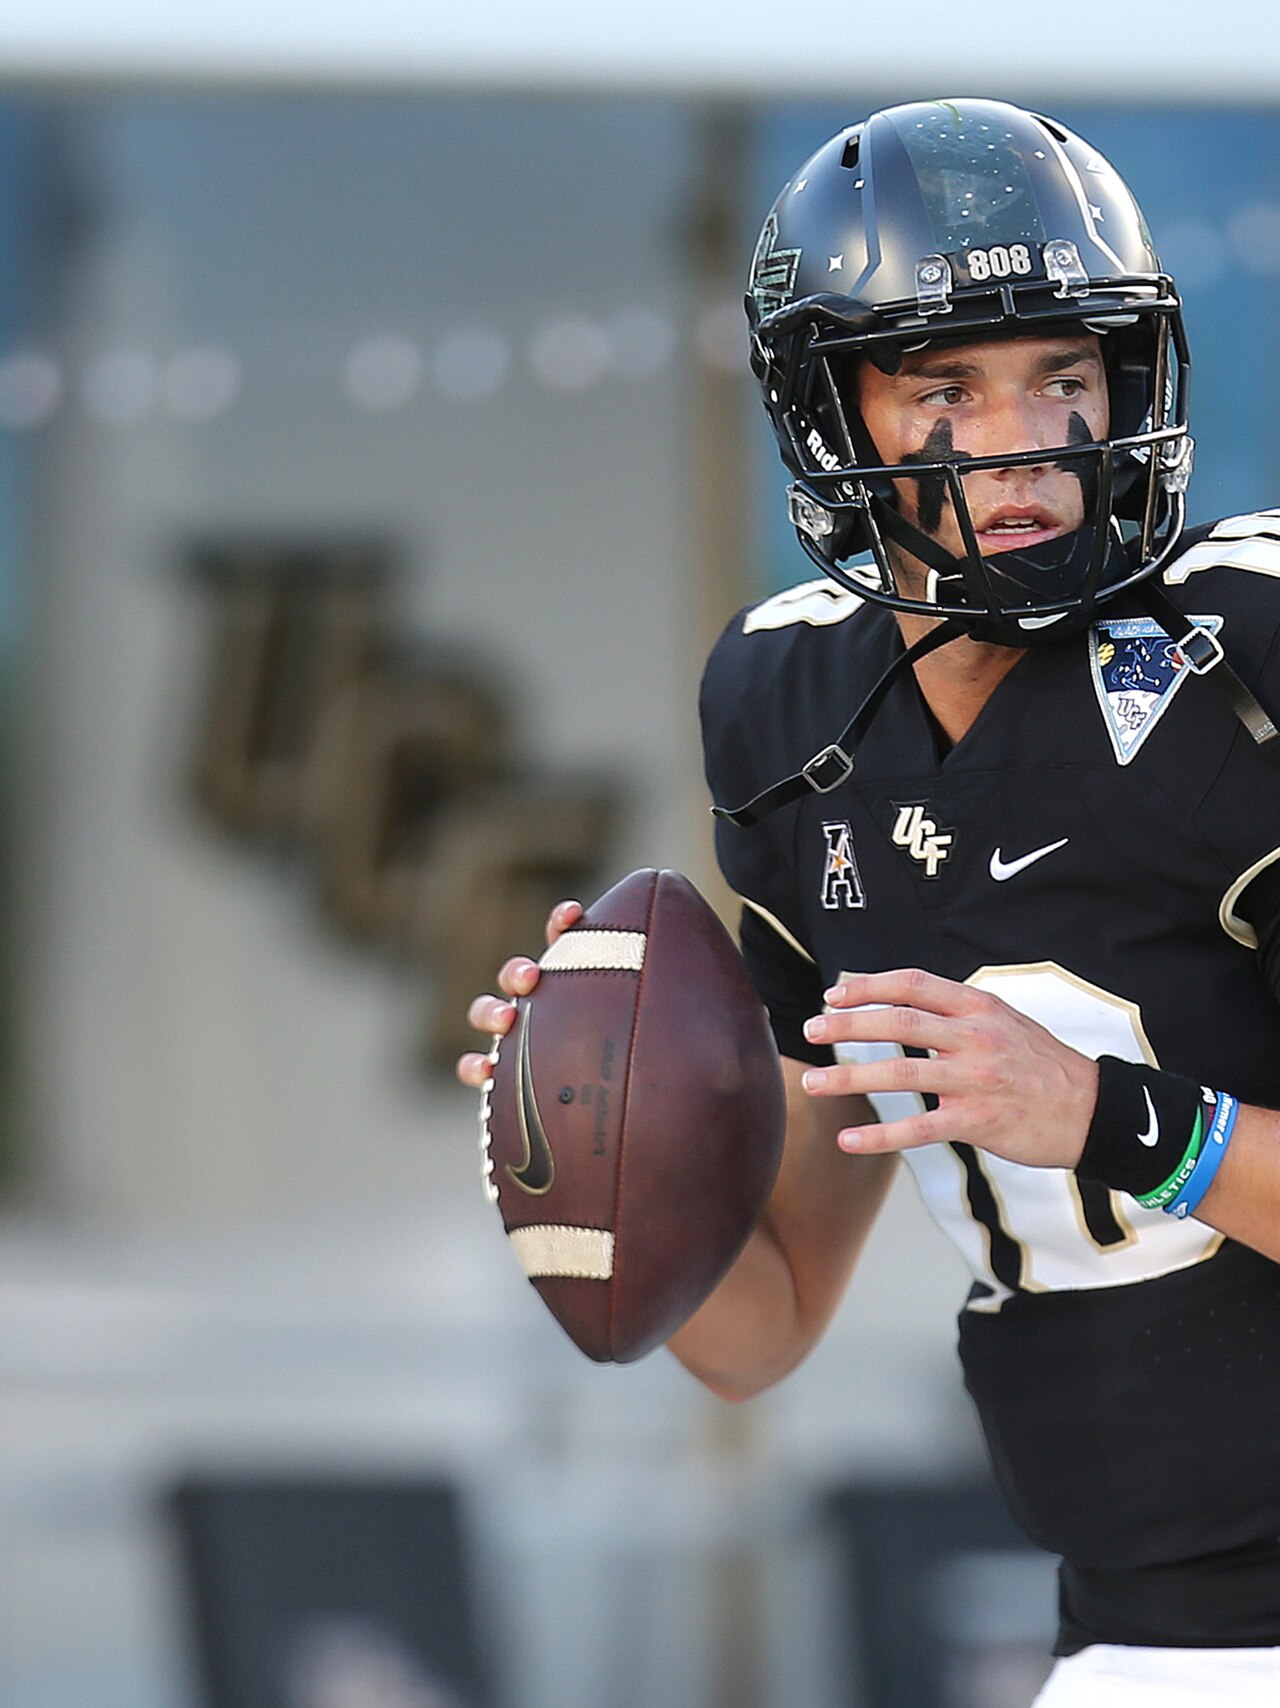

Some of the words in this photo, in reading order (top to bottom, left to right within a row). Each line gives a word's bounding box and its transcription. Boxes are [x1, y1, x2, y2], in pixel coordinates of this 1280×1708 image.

[967, 244, 1032, 280] 808
[1117, 698, 1147, 730] UCF
[892, 803, 953, 877] UCF
